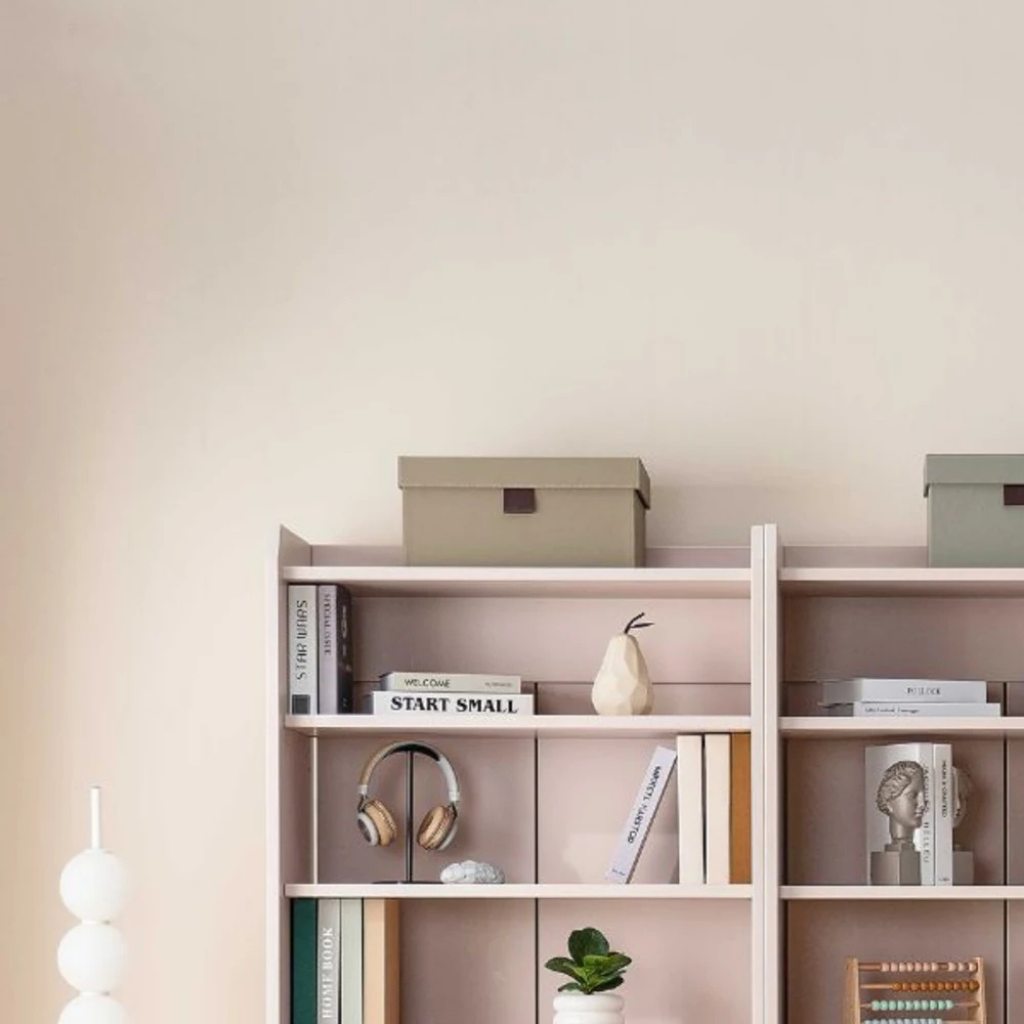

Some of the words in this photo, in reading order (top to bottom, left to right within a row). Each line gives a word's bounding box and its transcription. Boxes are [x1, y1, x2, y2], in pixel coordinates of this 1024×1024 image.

[296, 600, 308, 639] WARS
[296, 643, 308, 680] STAR
[404, 678, 450, 687] WELCOME
[390, 696, 450, 711] START
[456, 697, 518, 713] SMALL
[322, 927, 333, 970] BOOK
[322, 973, 333, 1019] HOME
